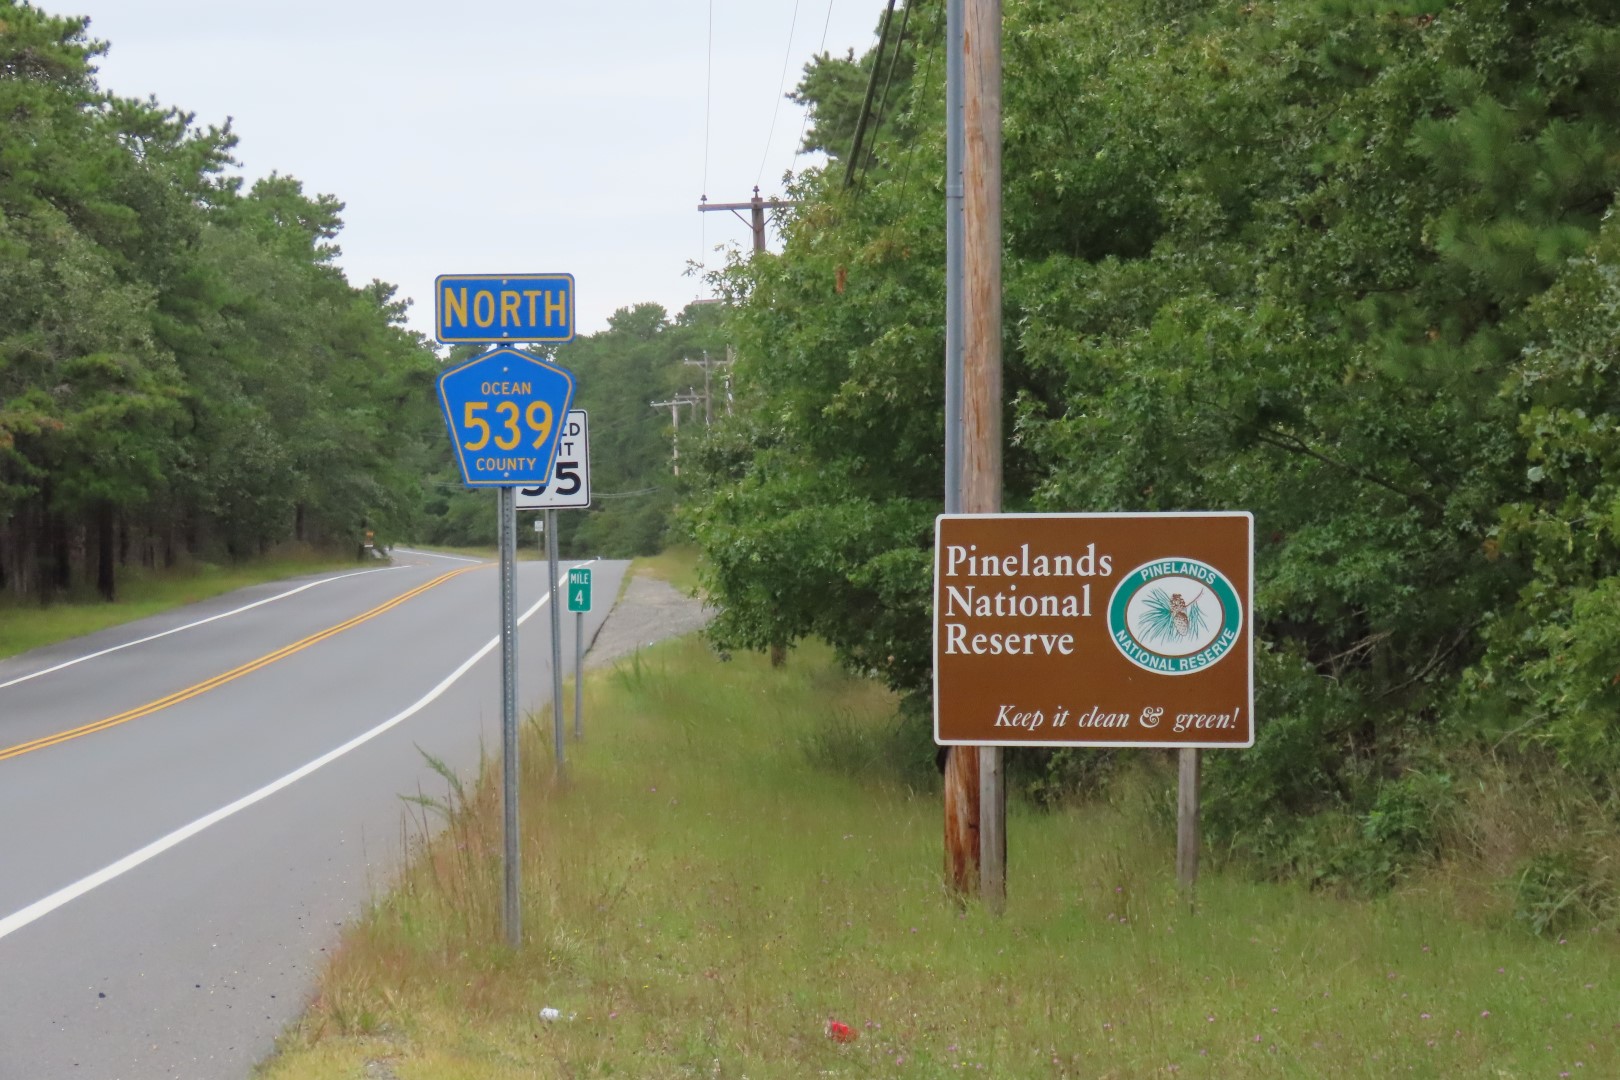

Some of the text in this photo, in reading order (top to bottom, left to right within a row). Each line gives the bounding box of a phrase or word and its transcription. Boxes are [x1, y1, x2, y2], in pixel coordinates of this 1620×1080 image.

[444, 287, 566, 328] NORTH
[481, 381, 532, 395] OCEAN
[464, 400, 553, 450] 539
[476, 457, 537, 471] COUNTY
[945, 543, 1113, 577] Pinelands
[1140, 562, 1216, 585] PINELANDS
[570, 573, 589, 584] MILE
[575, 590, 583, 605] 4
[945, 584, 1092, 618] National
[945, 623, 1074, 656] Reserve
[1116, 627, 1235, 671] NATIONAL RESERVE
[994, 705, 1240, 733] Keep it clean & green!
